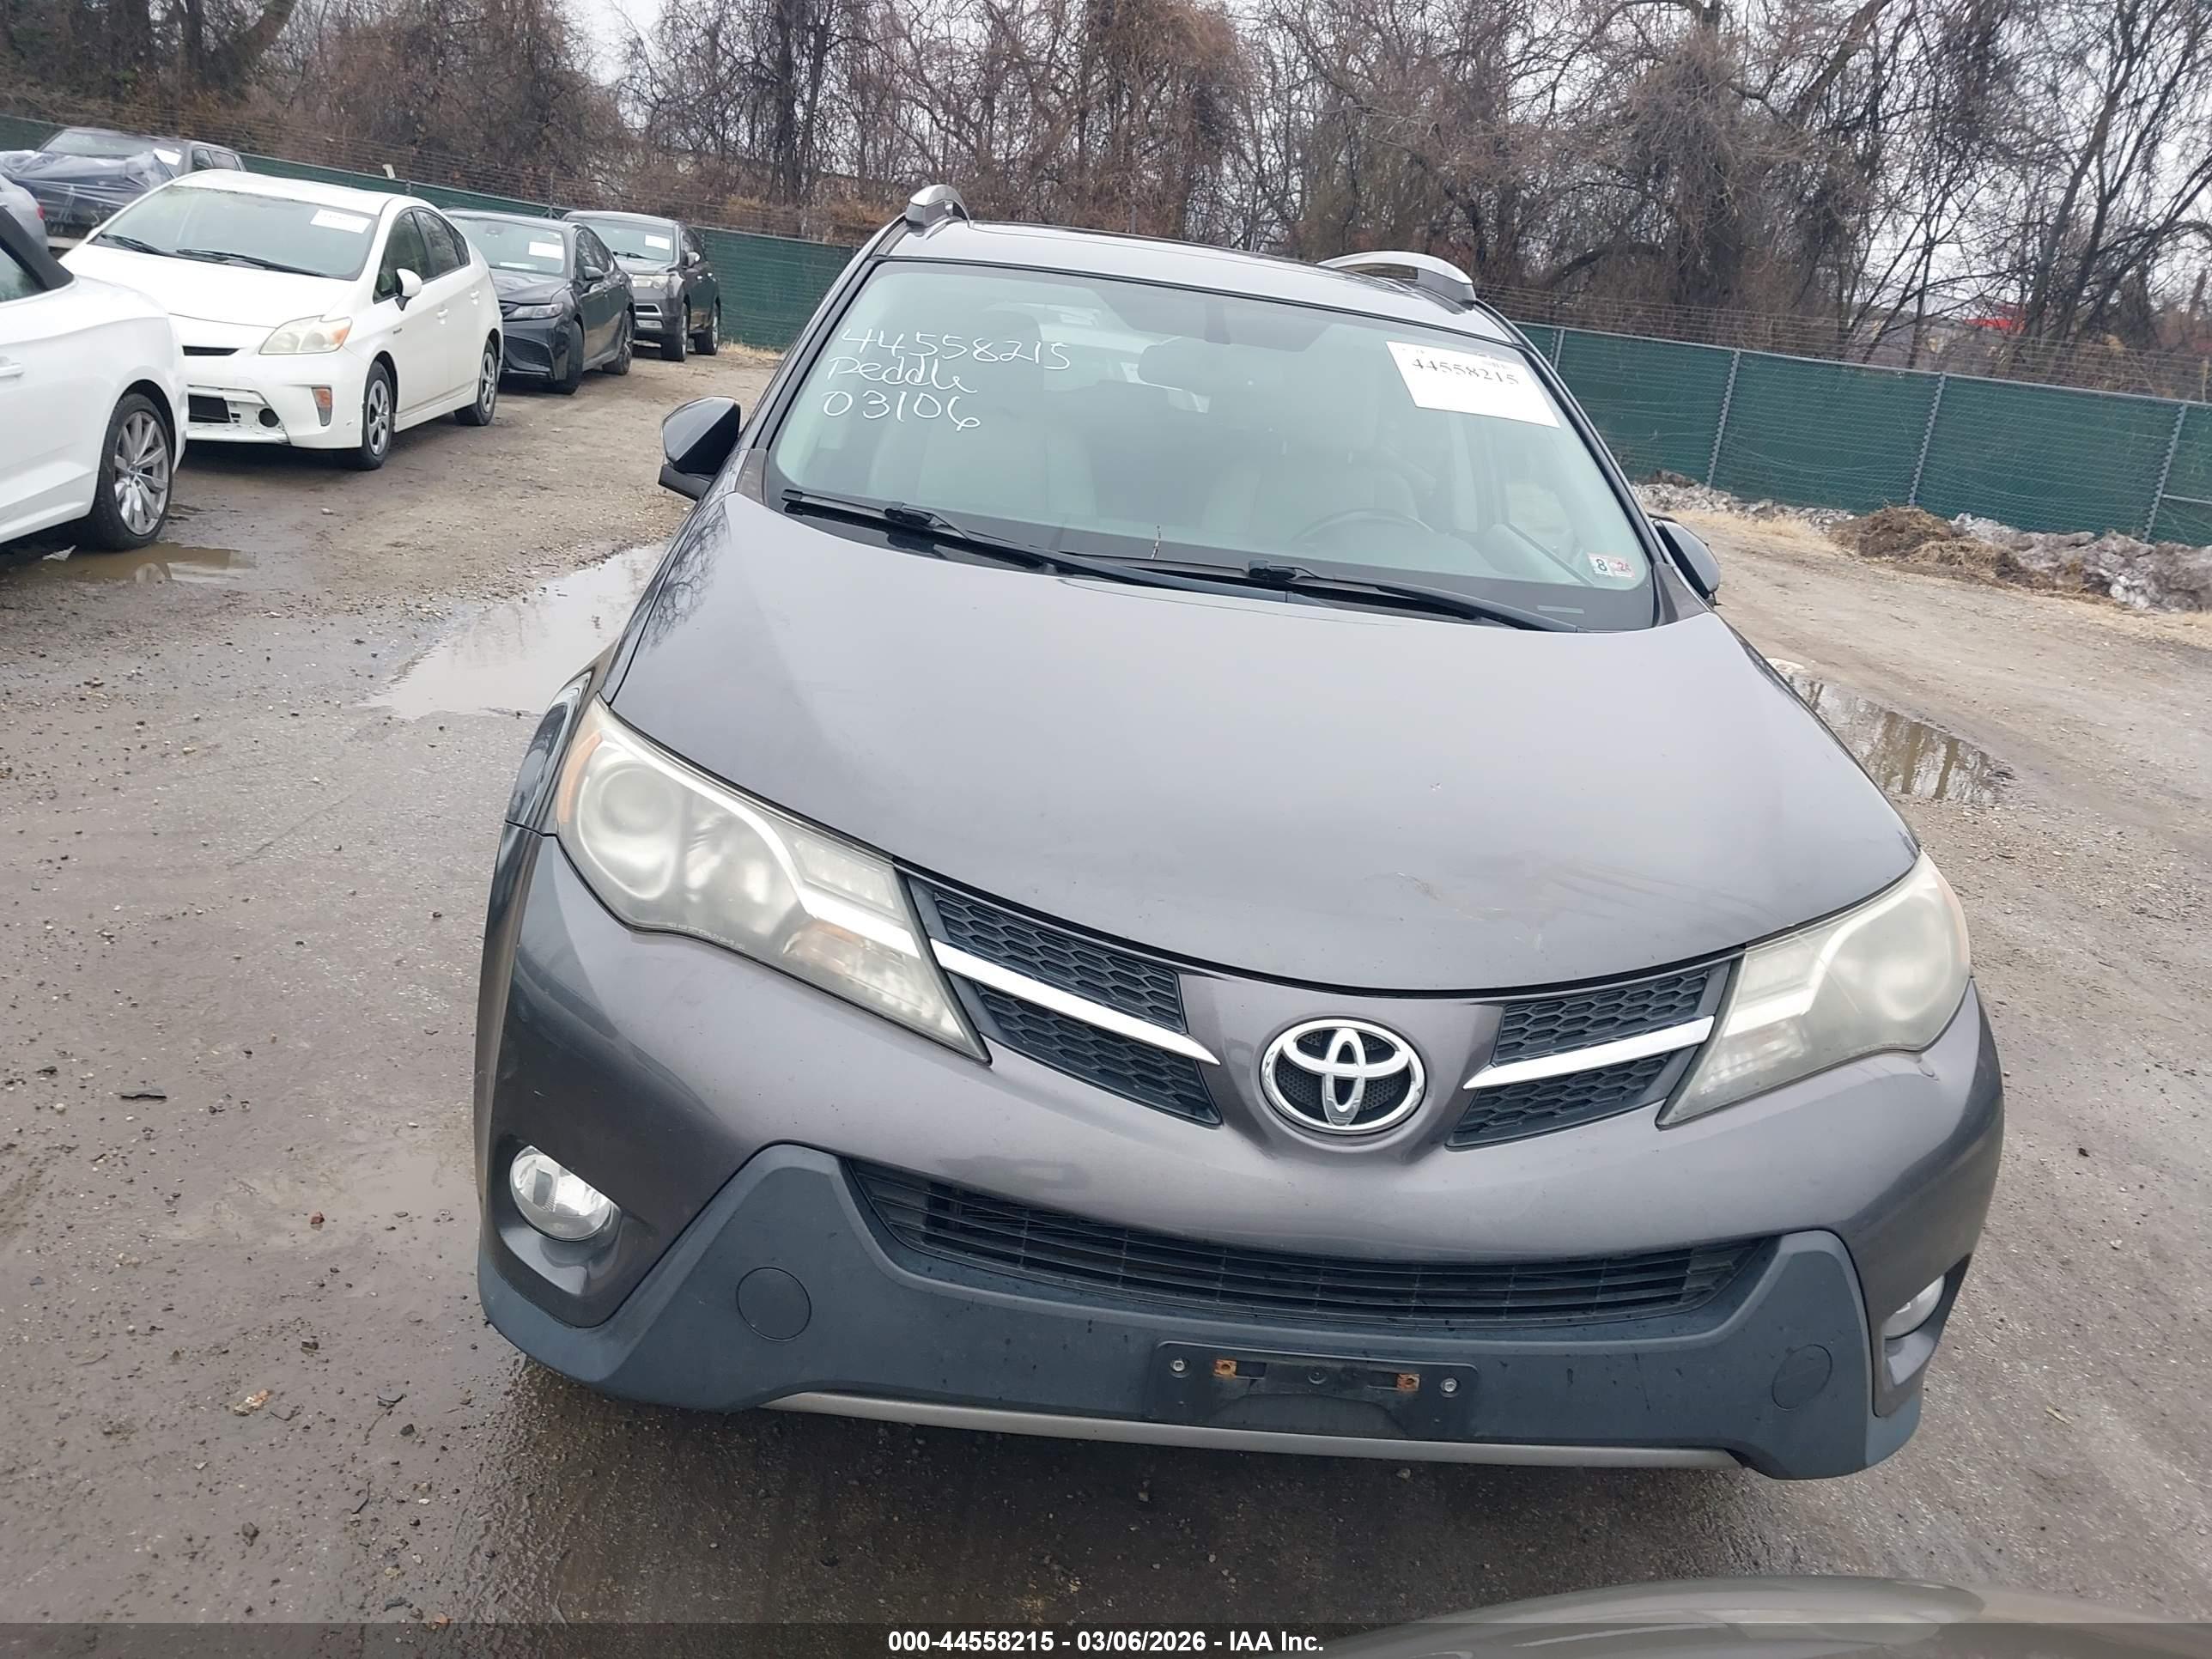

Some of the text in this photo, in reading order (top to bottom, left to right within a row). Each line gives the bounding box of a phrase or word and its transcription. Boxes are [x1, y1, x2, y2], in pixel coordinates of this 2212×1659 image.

[842, 328, 1071, 370] 44558215
[1413, 357, 1520, 385] 44558215
[1595, 557, 1607, 572] 8
